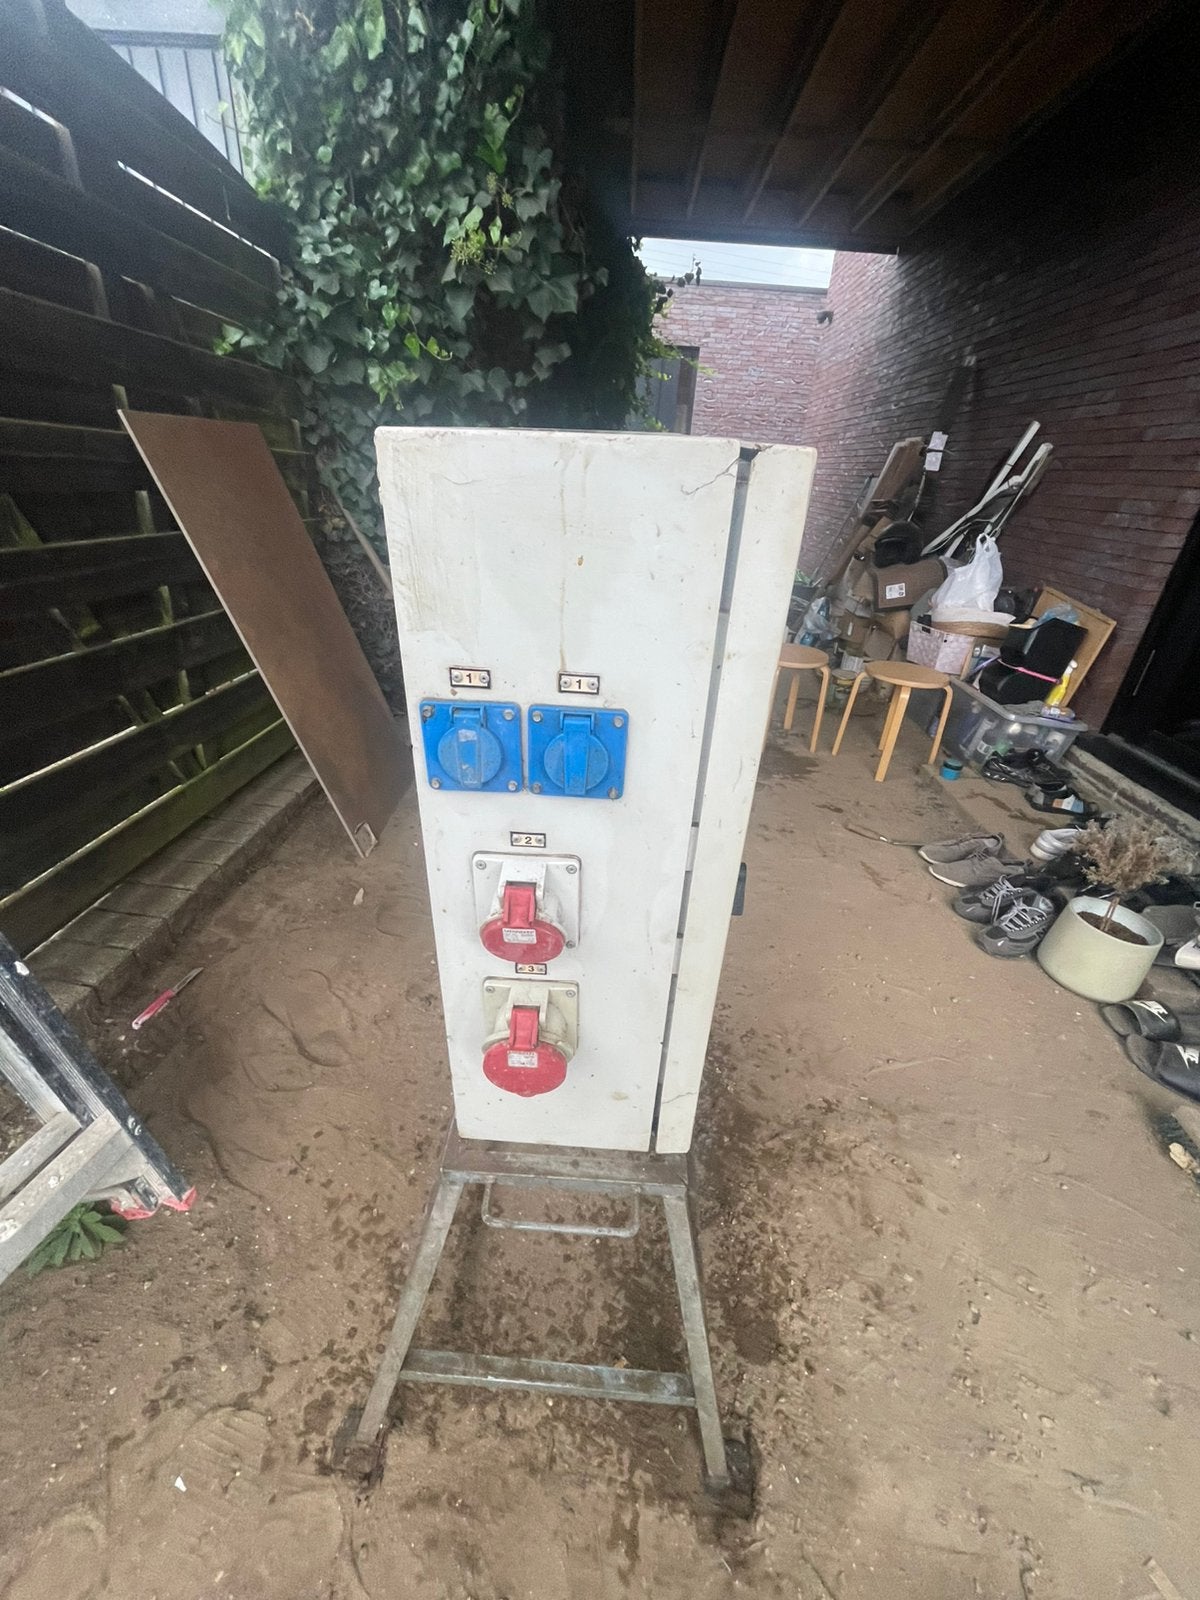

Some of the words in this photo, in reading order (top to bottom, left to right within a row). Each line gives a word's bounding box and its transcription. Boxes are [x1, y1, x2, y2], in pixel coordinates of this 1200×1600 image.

[466, 673, 472, 684] 1
[576, 679, 582, 690] 1
[524, 836, 532, 845] 2
[528, 965, 535, 973] 3
